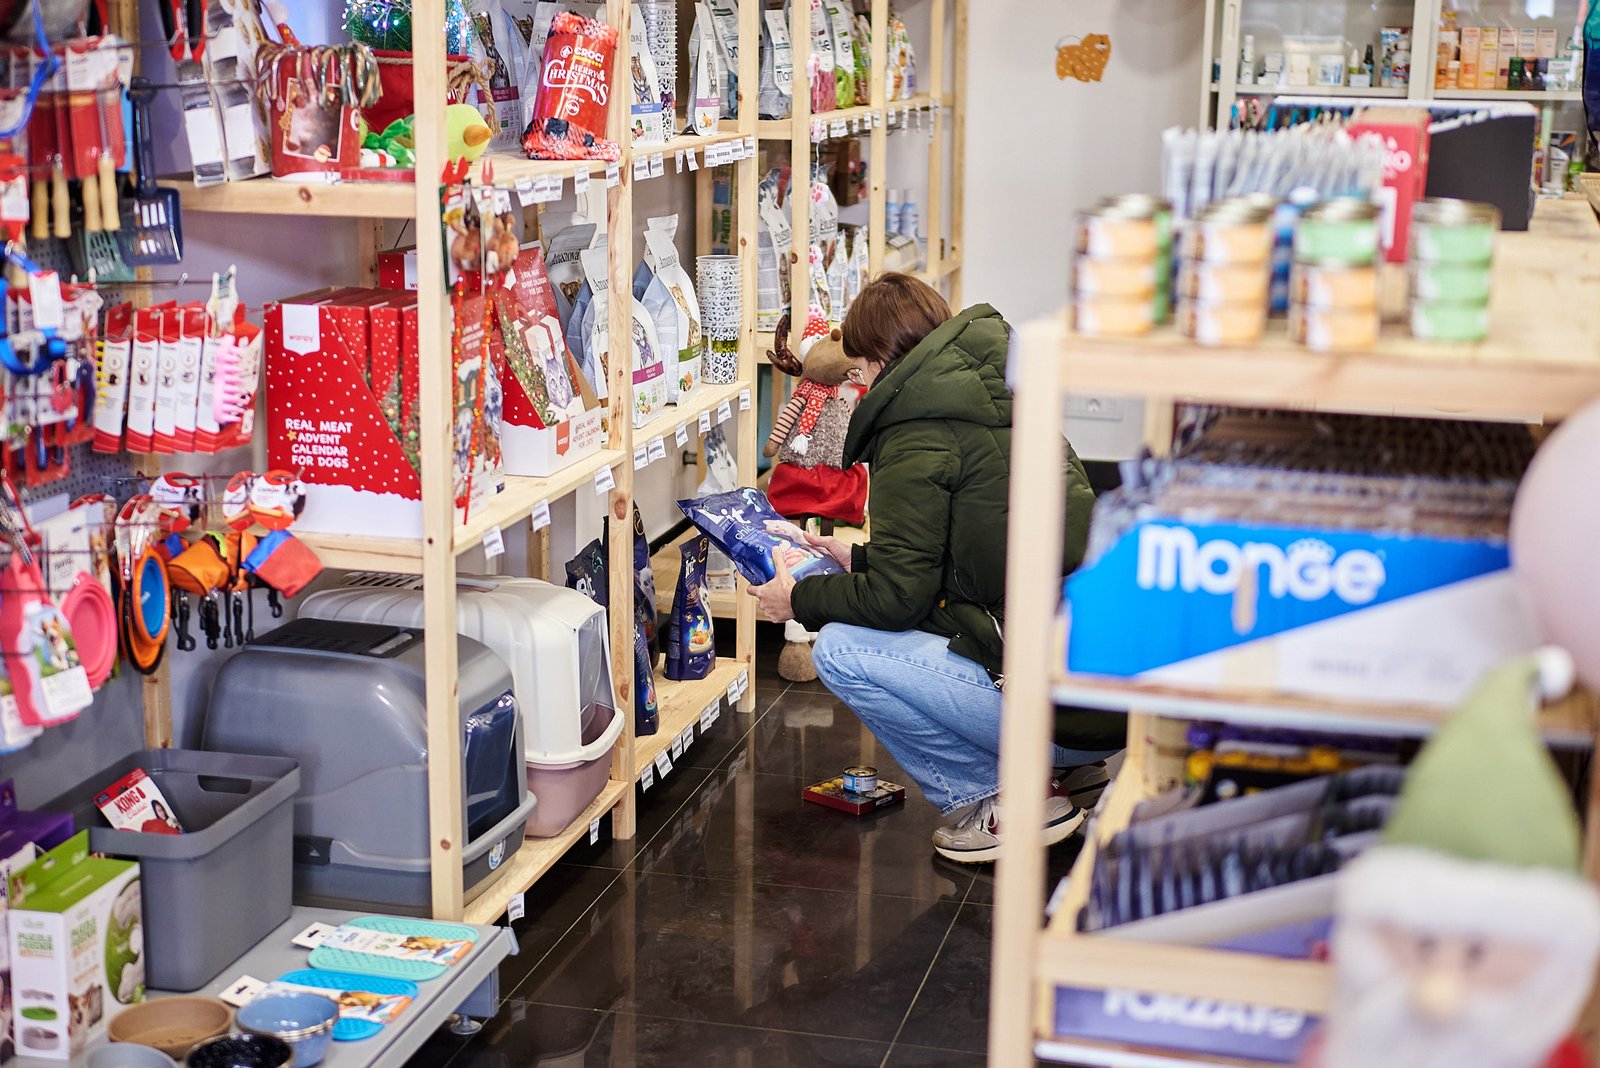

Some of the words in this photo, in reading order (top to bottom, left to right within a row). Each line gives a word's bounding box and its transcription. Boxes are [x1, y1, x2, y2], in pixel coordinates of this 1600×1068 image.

[575, 48, 604, 63] CROCI
[545, 60, 609, 106] CHRISTMAS
[285, 418, 316, 431] REAL
[320, 421, 353, 433] MEAT
[298, 432, 342, 445] ADVENT
[291, 443, 349, 457] CALENDAR
[291, 455, 314, 466] FOR
[317, 456, 349, 469] DOGS
[114, 790, 141, 814] KONG
